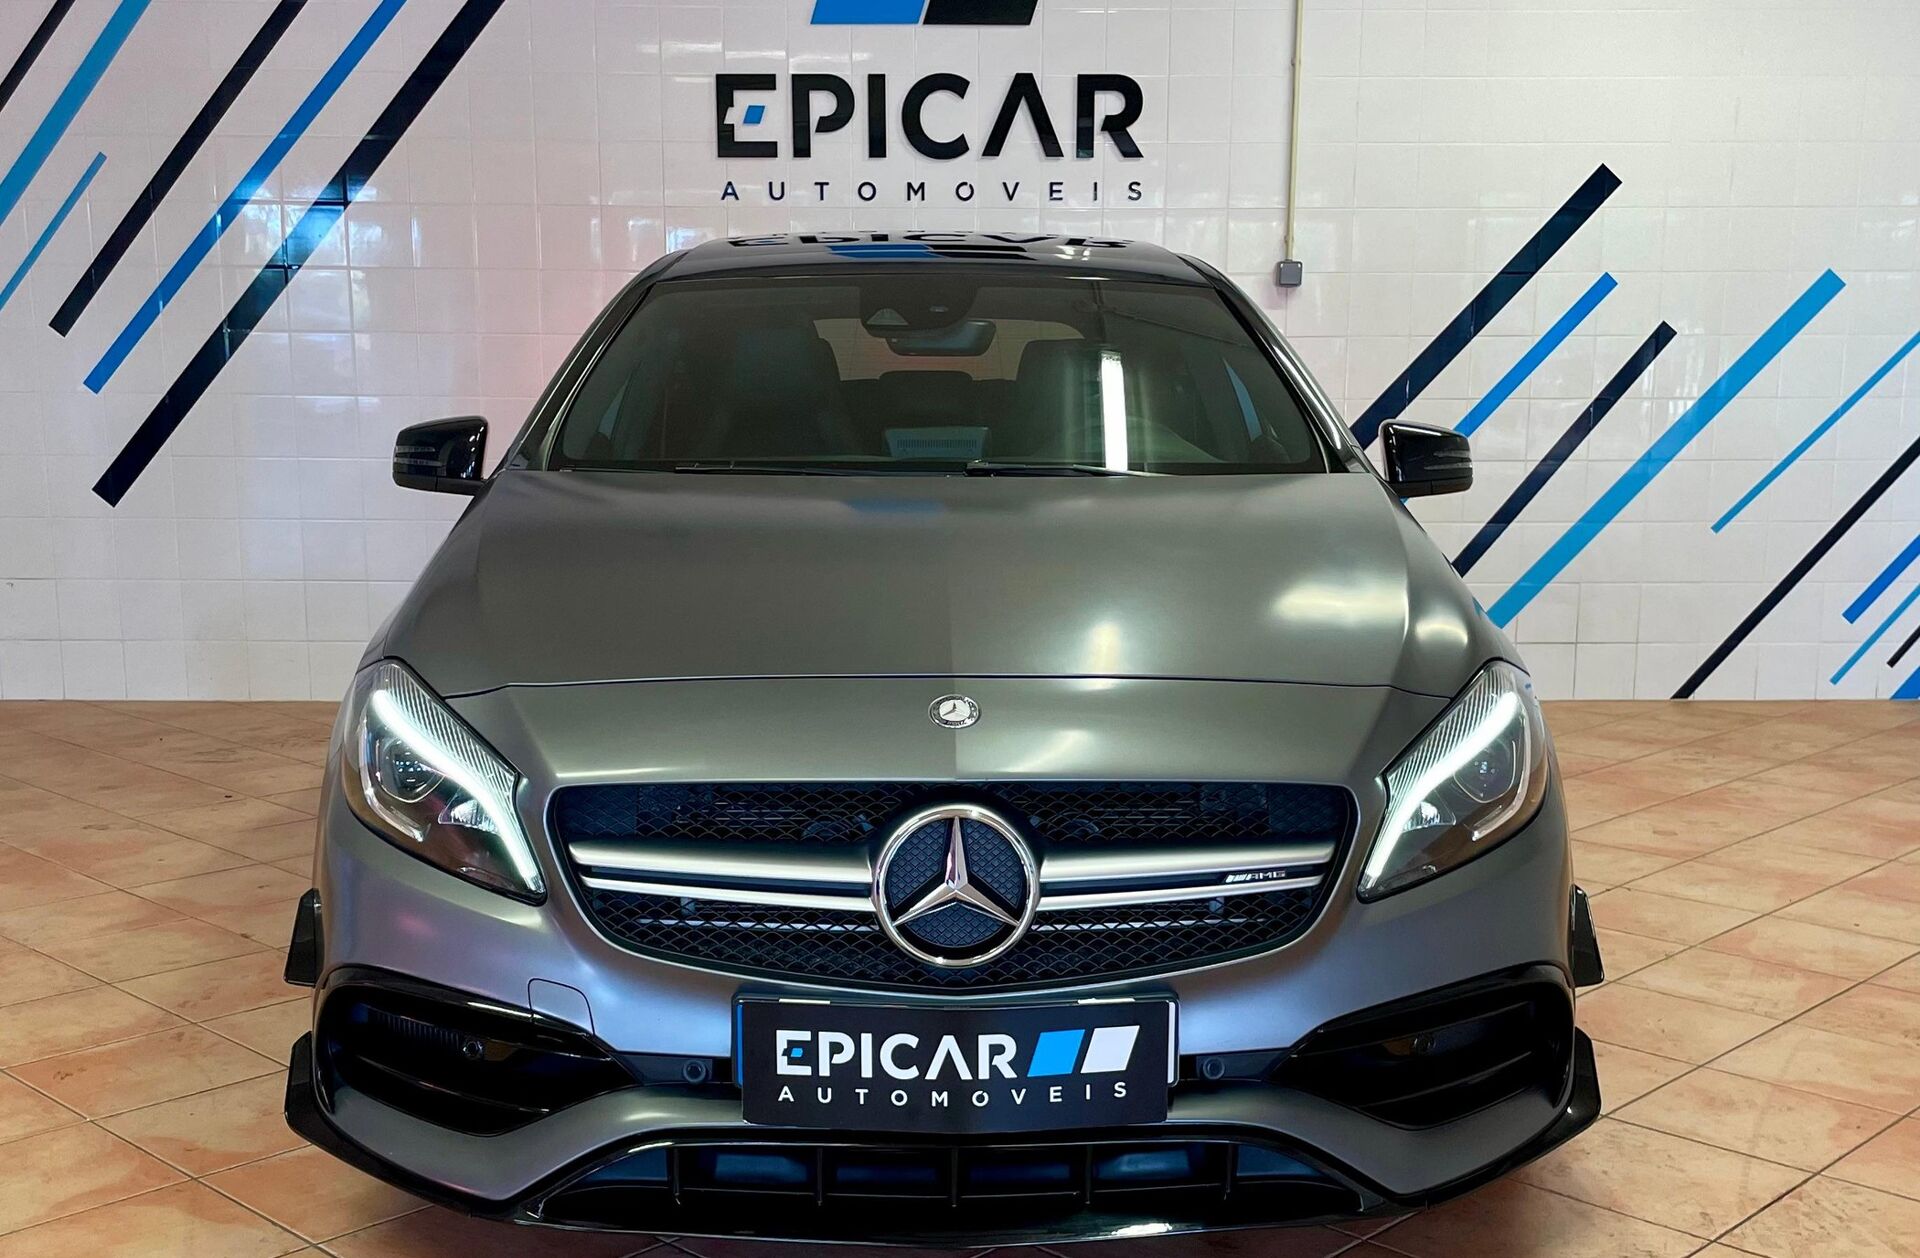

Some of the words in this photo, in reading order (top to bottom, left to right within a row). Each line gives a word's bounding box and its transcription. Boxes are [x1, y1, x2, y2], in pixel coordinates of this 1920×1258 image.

[715, 72, 1144, 159] EPICAR
[1247, 870, 1286, 880] AMG
[775, 1029, 1018, 1080] EPICAR
